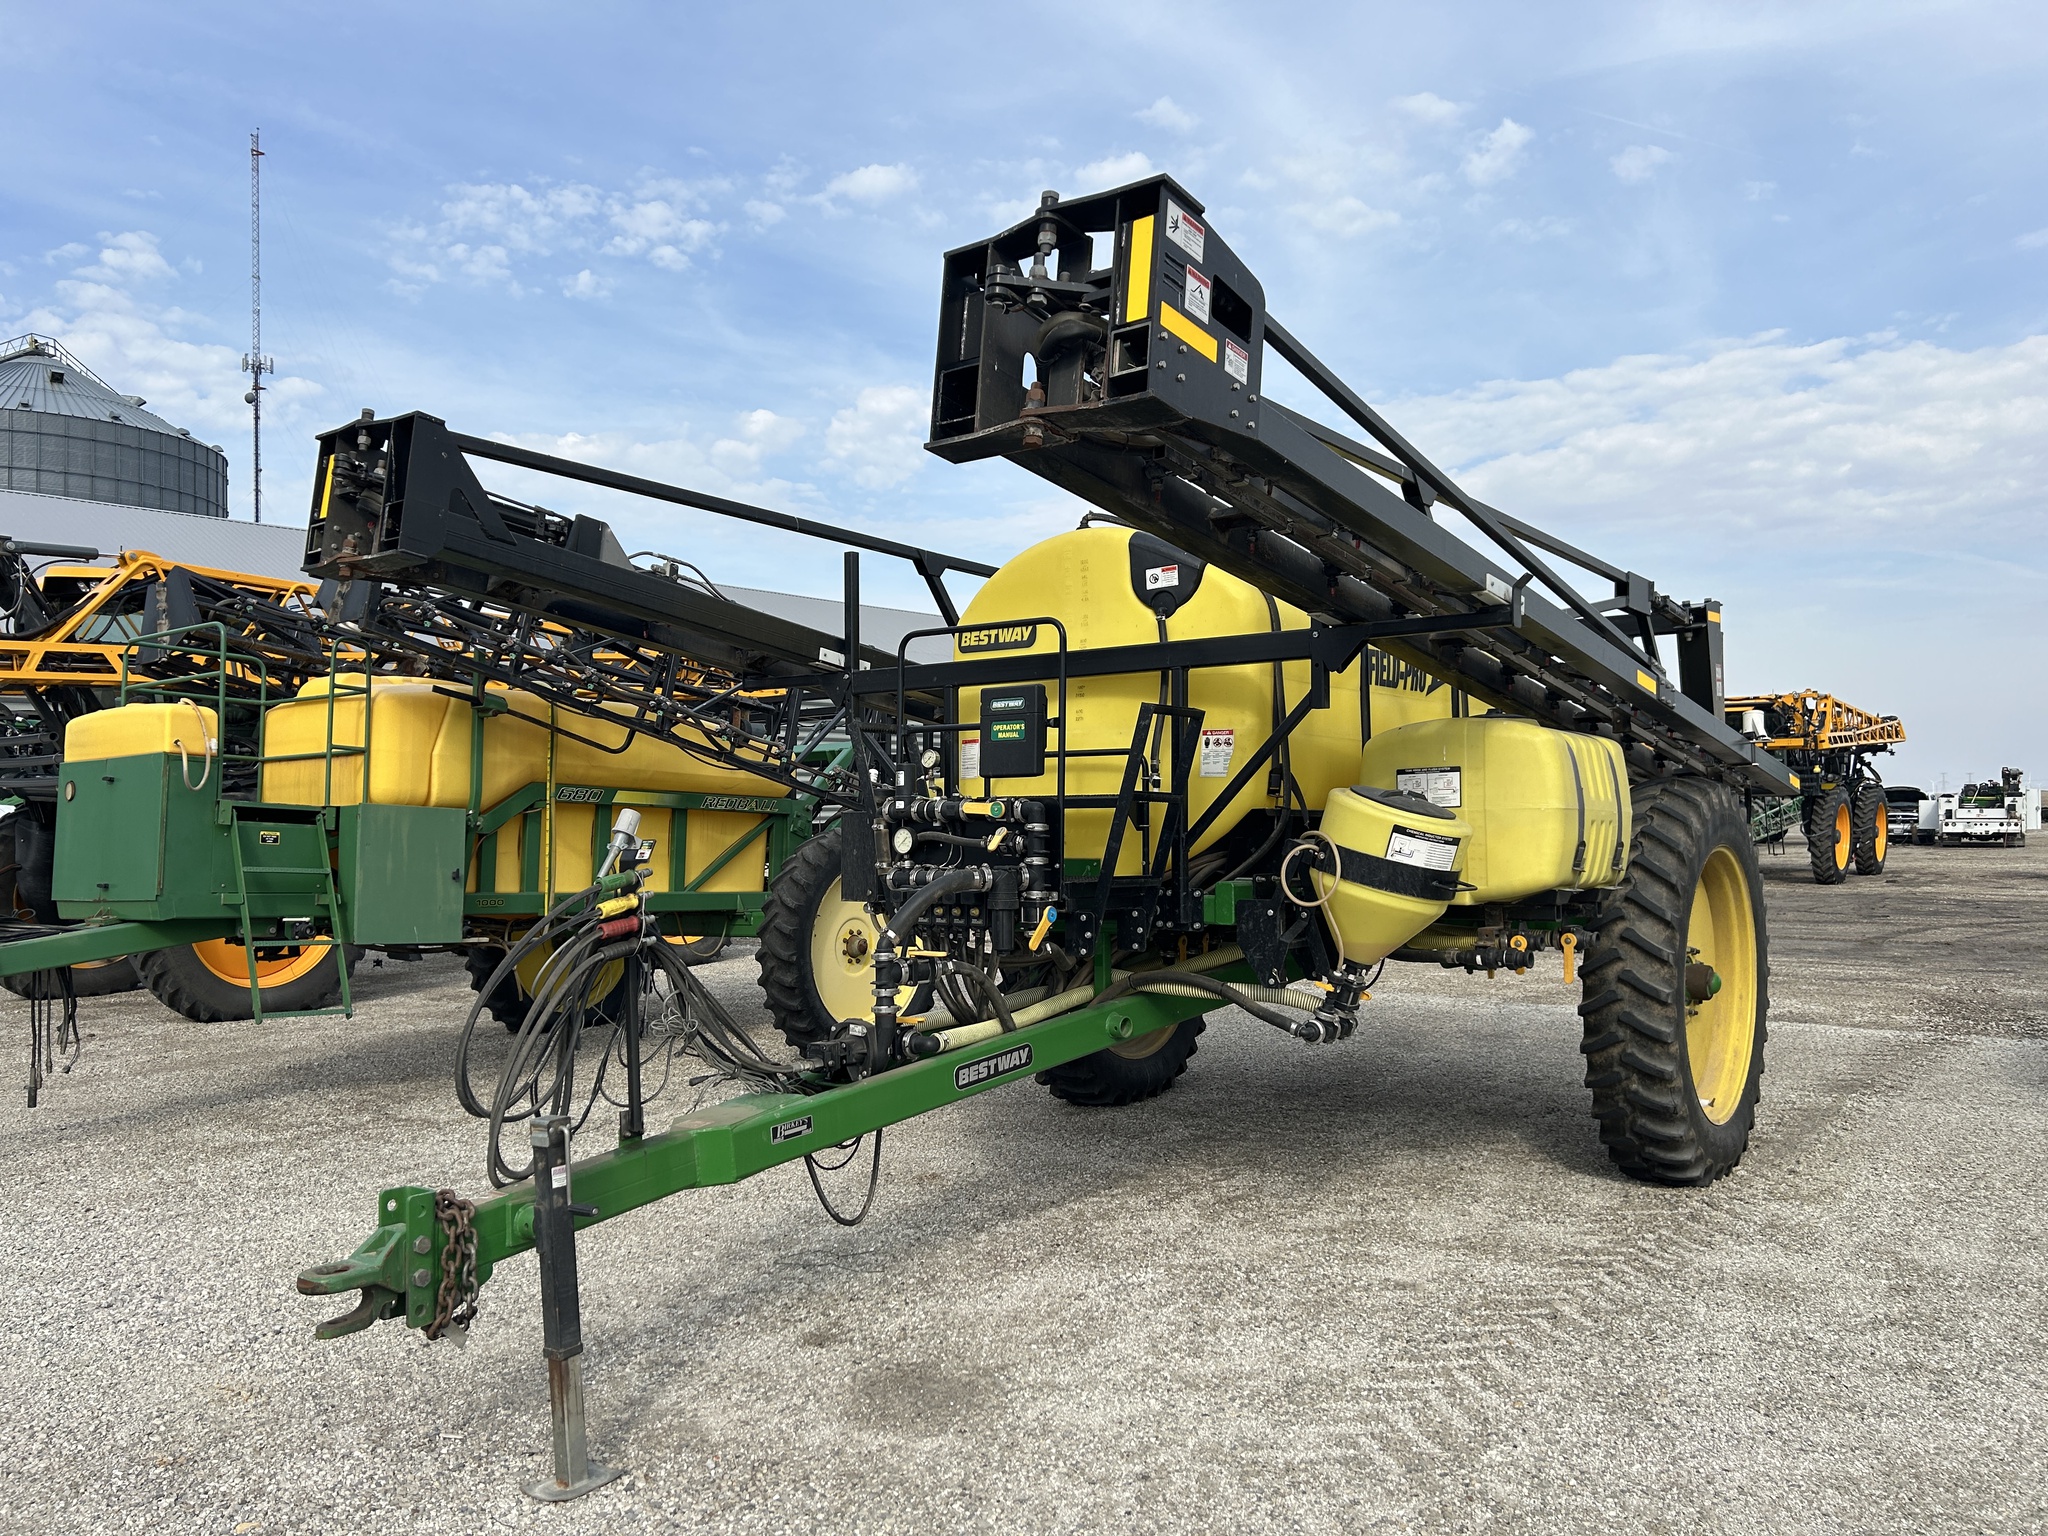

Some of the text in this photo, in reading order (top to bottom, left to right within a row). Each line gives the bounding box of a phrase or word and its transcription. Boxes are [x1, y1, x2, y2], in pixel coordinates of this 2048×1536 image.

[961, 626, 1033, 646] BESTWAY
[992, 699, 1024, 708] BESTWAY
[556, 787, 778, 812] 680 REDBALL
[476, 899, 505, 907] 1000
[958, 1047, 1029, 1086] BESTWAY
